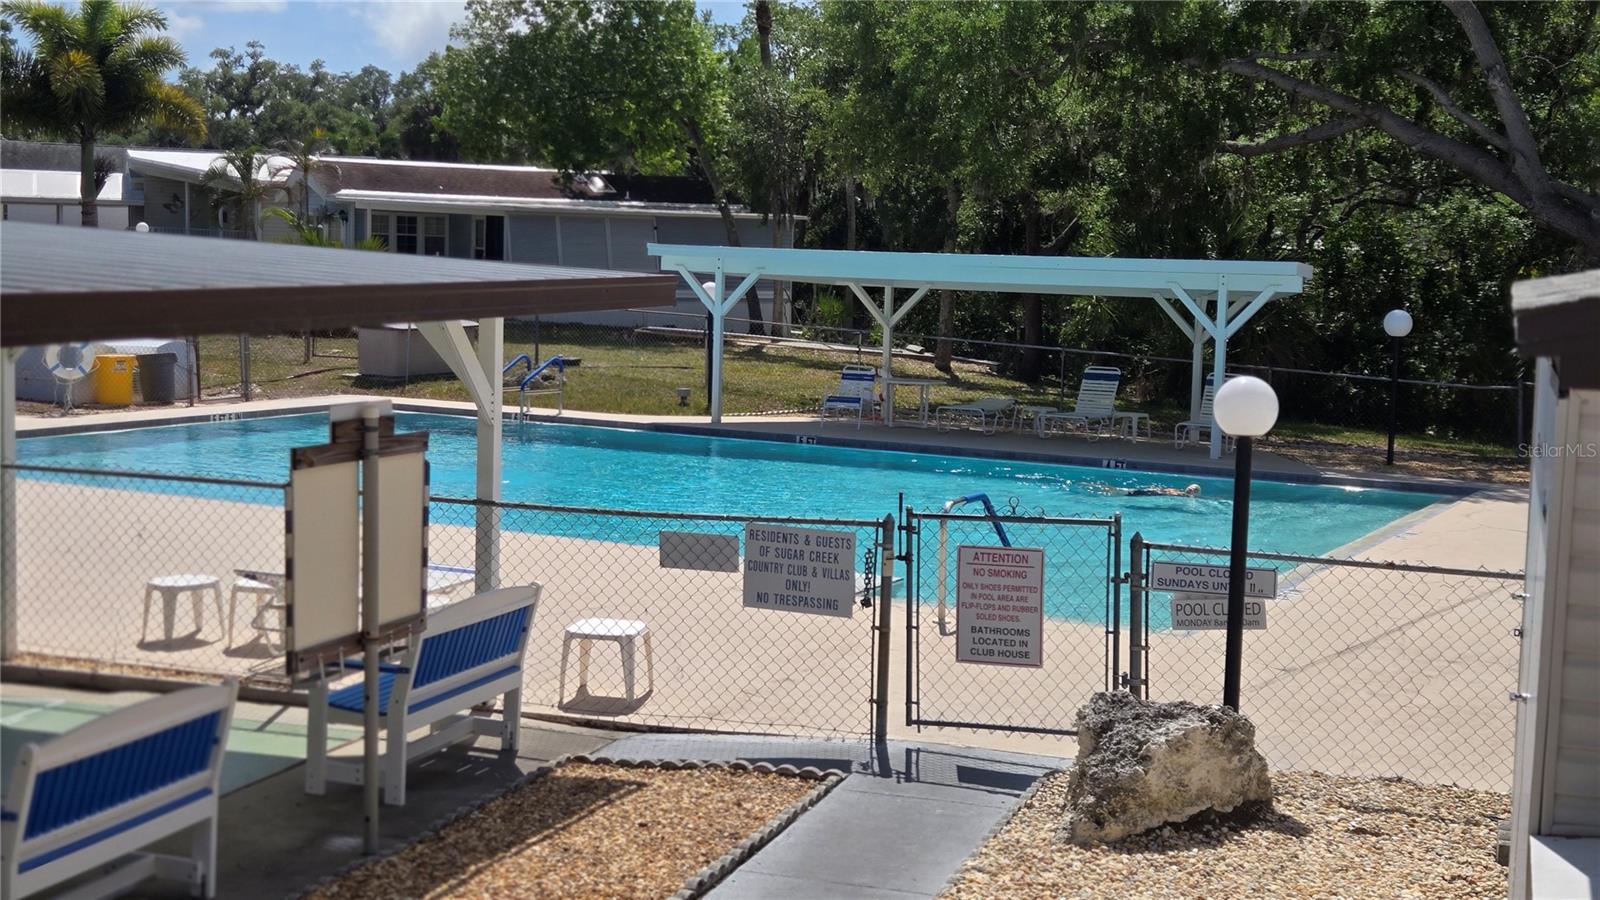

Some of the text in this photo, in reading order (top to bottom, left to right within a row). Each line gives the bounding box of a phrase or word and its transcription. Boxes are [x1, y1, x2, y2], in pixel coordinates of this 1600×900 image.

[749, 529, 852, 550] RESIDENTS & GUESTS
[759, 545, 840, 565] OF SUGAR CREEK
[973, 552, 1029, 564] ATTENTION
[747, 559, 850, 581] COUNTRY CLUB & VILLAS
[973, 568, 1028, 580] NO SMOKING
[1175, 566, 1254, 580] POOL CLOD
[785, 578, 811, 592] ONLY!
[962, 582, 1039, 594] ONLY SHOES PERMITTED
[1157, 577, 1209, 591] SUNDAYS
[756, 591, 839, 611] NO TRESPASSING
[979, 593, 996, 601] POOL
[997, 594, 1014, 602] AREA
[1016, 595, 1028, 603] ARE
[961, 602, 1039, 613] FLIP-FLOPS AND RUBBER
[1176, 602, 1261, 616] POOL CLED
[976, 613, 997, 621] SOLED
[1176, 619, 1212, 627] MONDAY
[971, 626, 1031, 638] BATHROOMS
[972, 637, 1029, 648] LOCATED IN
[970, 647, 1031, 659] CLUB HOUSE
